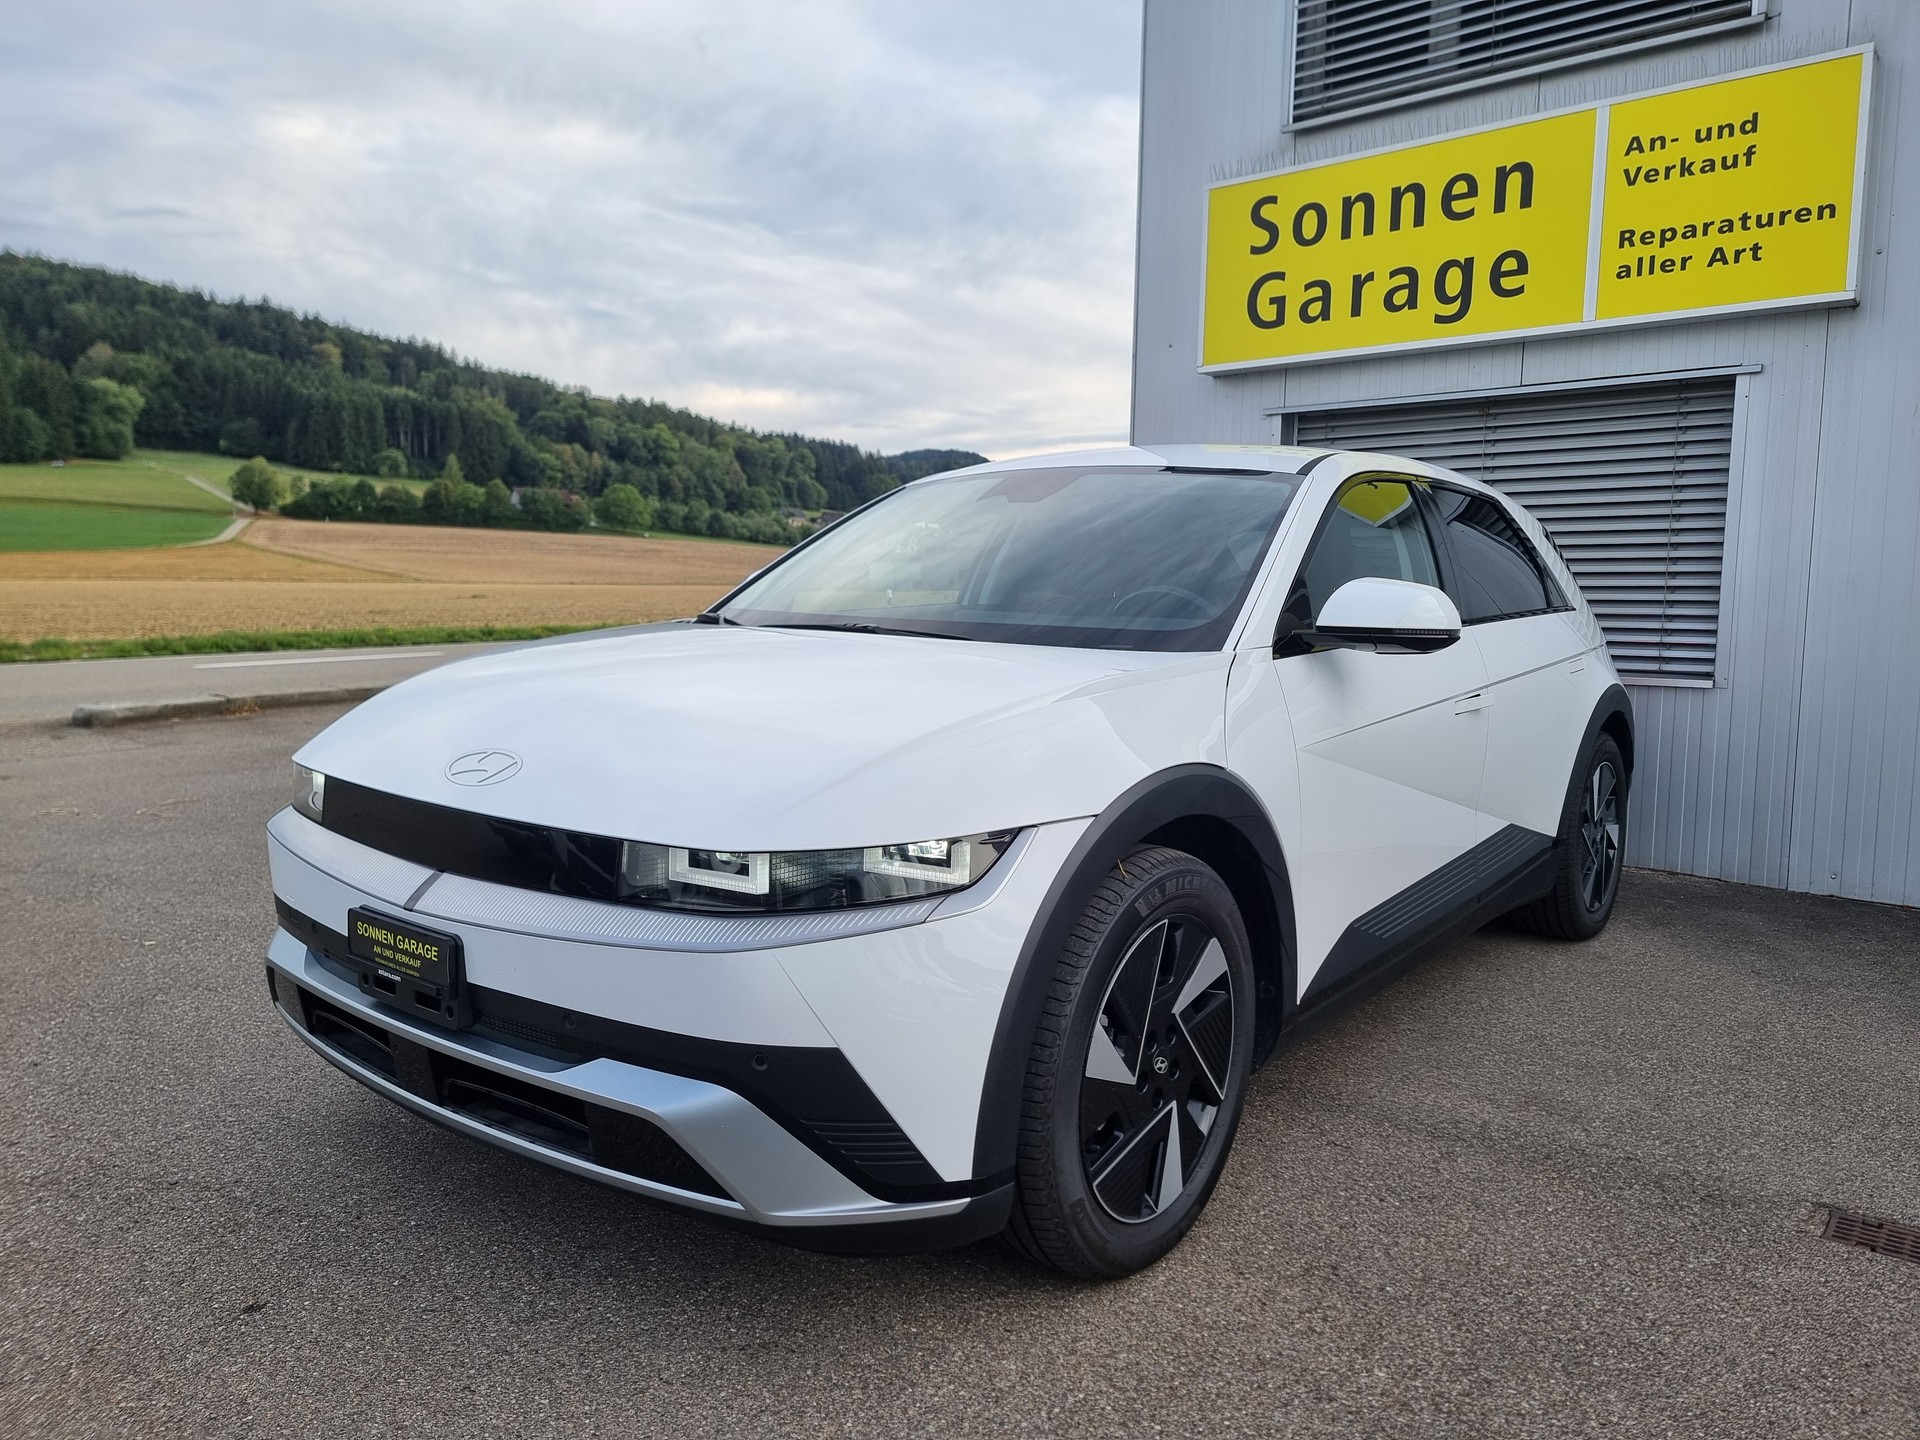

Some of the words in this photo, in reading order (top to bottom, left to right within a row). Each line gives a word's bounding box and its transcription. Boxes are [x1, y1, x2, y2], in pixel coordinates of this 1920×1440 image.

[1624, 135, 1679, 157] An-
[1695, 112, 1759, 144] und
[1623, 145, 1757, 187] Verkauf
[1250, 161, 1534, 256] Sonnen
[1618, 203, 1837, 250] Reparaturen
[1615, 253, 1693, 280] aller
[1707, 242, 1763, 268] Art
[1246, 249, 1529, 330] Garage
[357, 921, 394, 946] SONNEN
[397, 935, 439, 961] GARAGE
[373, 945, 381, 954] AN
[382, 948, 393, 959] UND
[395, 952, 421, 968] VERKAUF
